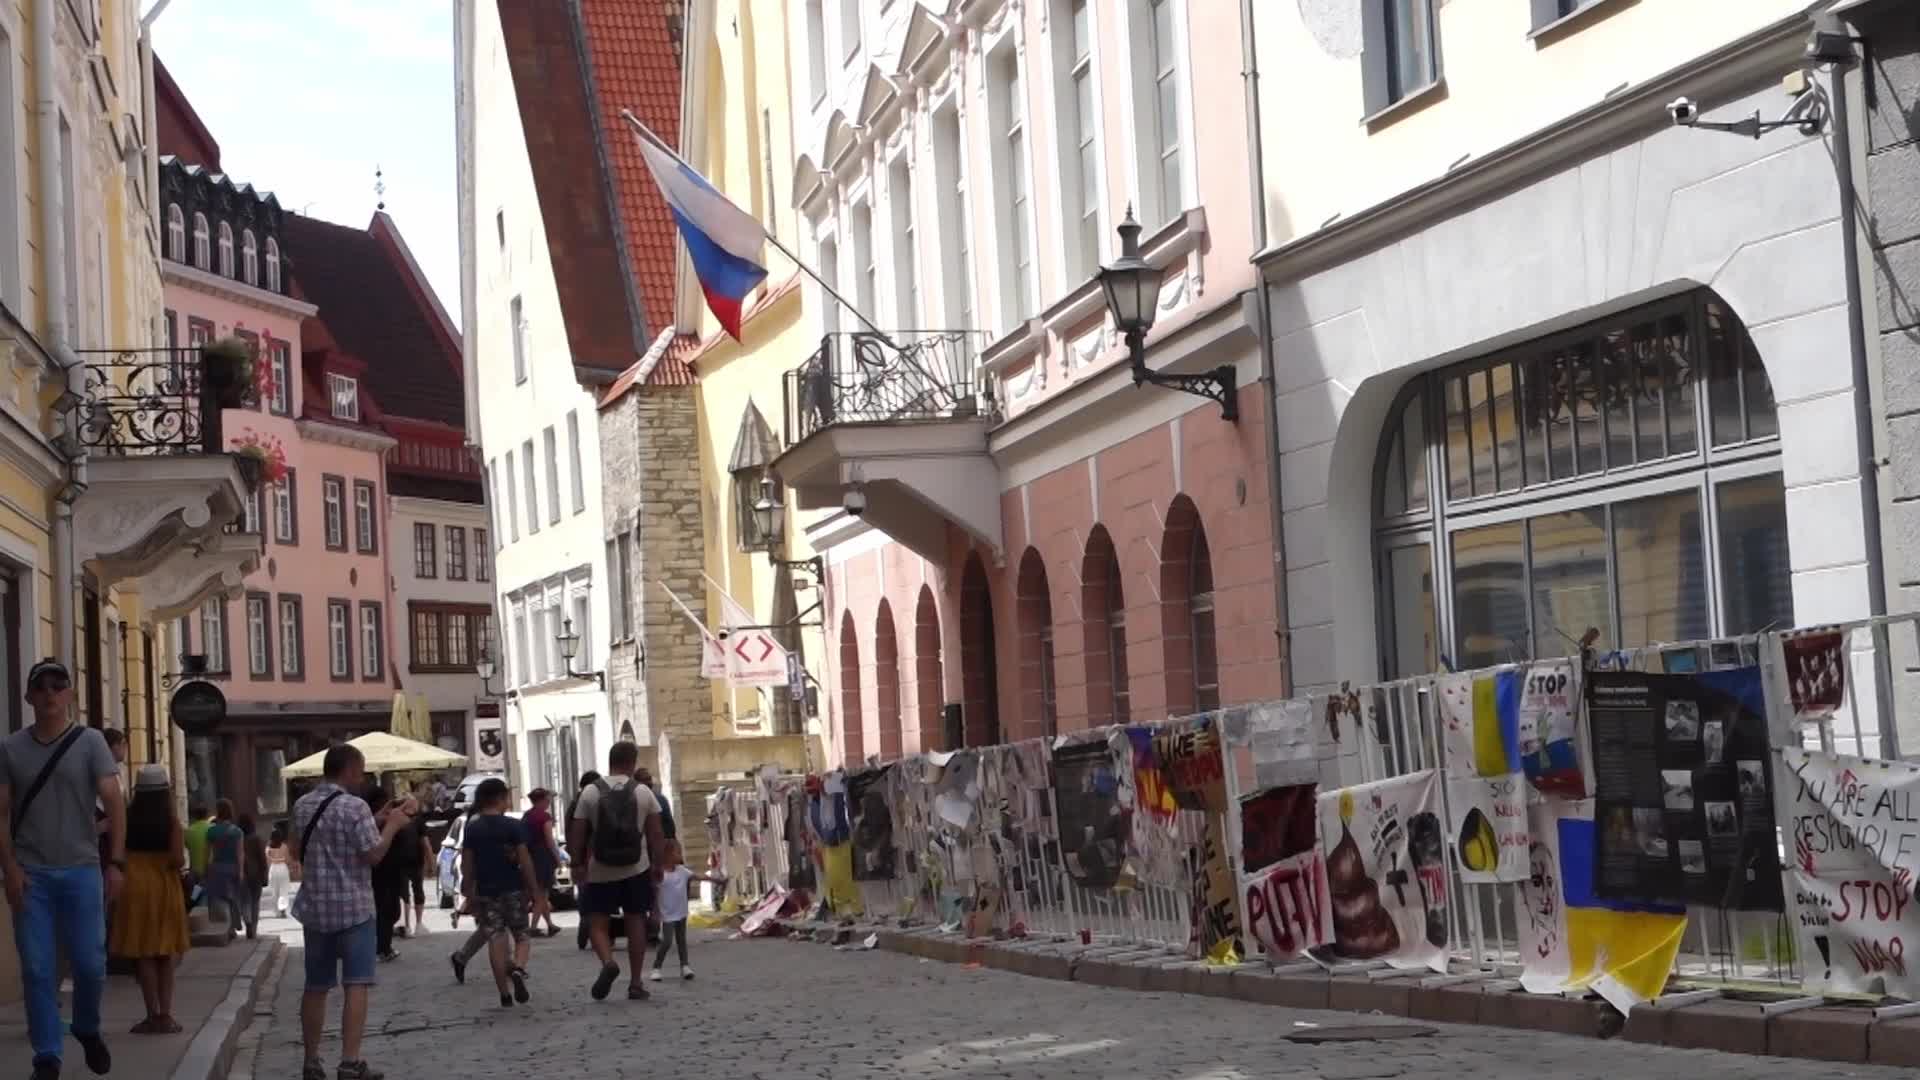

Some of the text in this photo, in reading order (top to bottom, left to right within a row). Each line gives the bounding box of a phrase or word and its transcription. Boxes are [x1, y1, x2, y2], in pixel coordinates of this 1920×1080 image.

[1527, 674, 1567, 695] STOP
[1786, 760, 1827, 804] YU
[1872, 788, 1918, 823] ALL
[1793, 814, 1917, 869] RESPOIBLE
[1831, 880, 1911, 921] STOP
[1846, 936, 1908, 977] WAR
